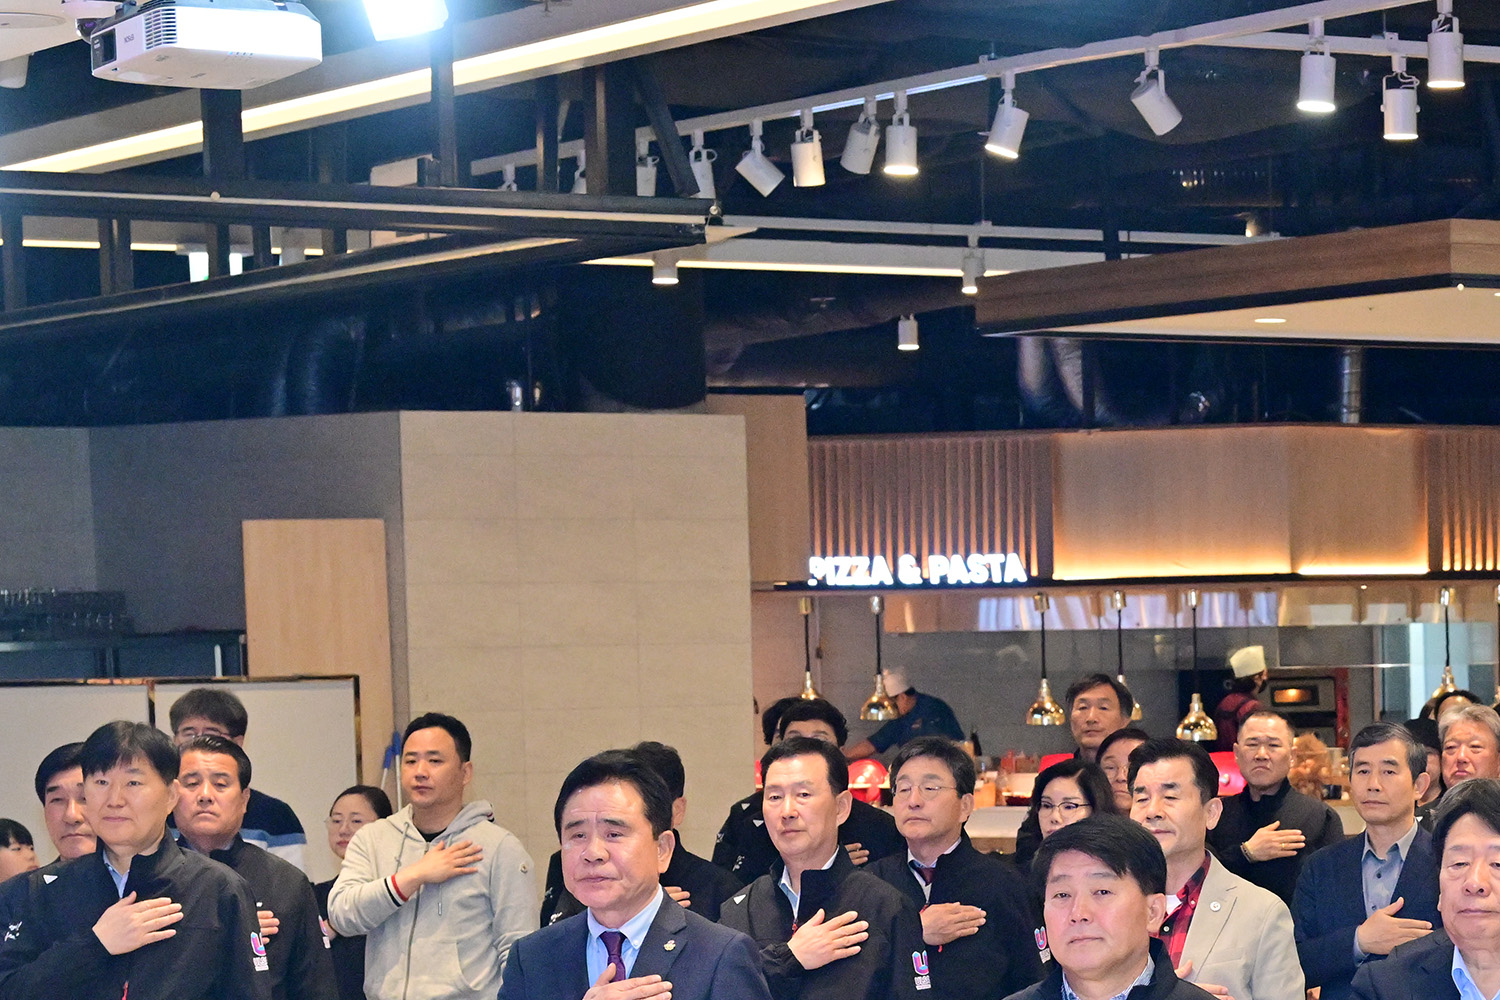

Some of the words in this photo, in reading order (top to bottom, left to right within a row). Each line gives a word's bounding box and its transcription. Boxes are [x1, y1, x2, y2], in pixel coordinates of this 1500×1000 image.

[807, 555, 894, 586] PIZZA
[897, 553, 923, 584] &
[928, 553, 1028, 585] PASTA
